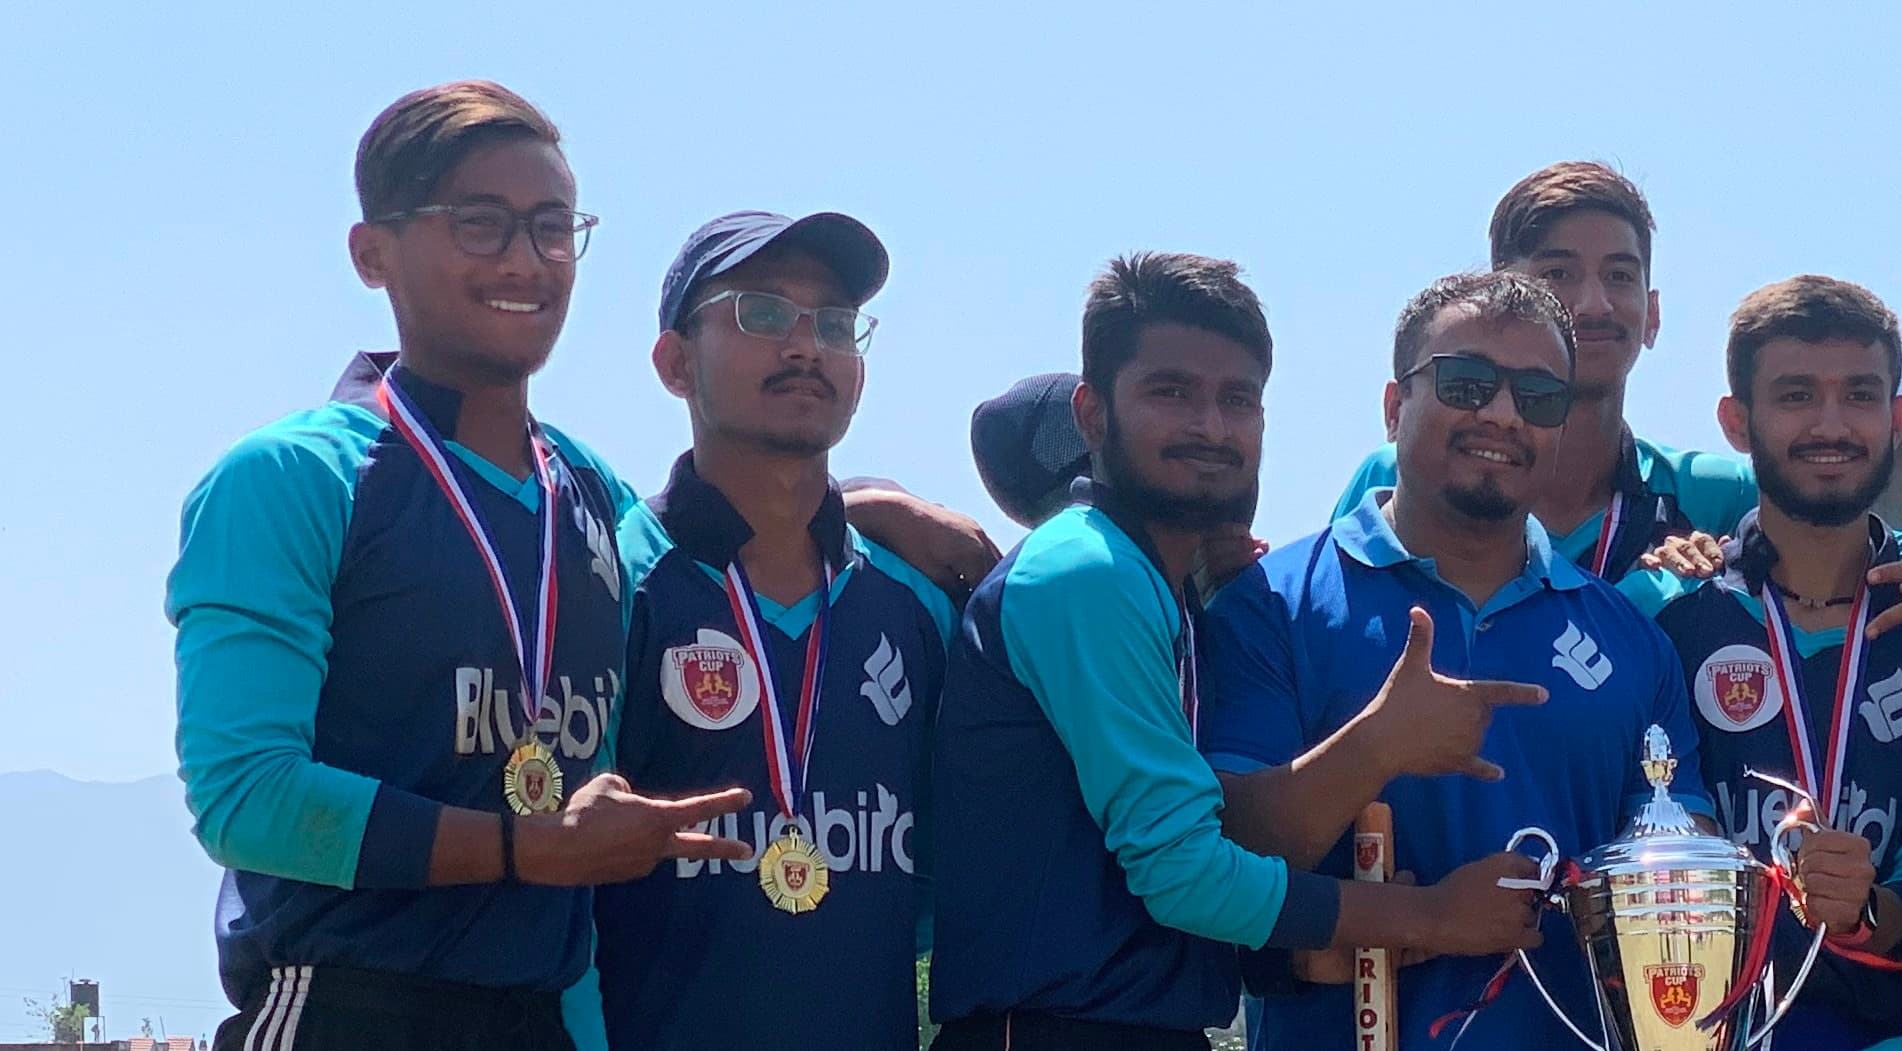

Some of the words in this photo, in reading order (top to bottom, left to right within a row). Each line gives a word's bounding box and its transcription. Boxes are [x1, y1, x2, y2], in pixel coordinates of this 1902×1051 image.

[678, 649, 741, 664] PATRIOTS
[699, 661, 723, 671] CUP
[1711, 663, 1769, 677] PATRIOTS
[1729, 672, 1752, 682] CUP
[1647, 966, 1702, 979] PATRIOTS
[1665, 976, 1687, 985] CUP
